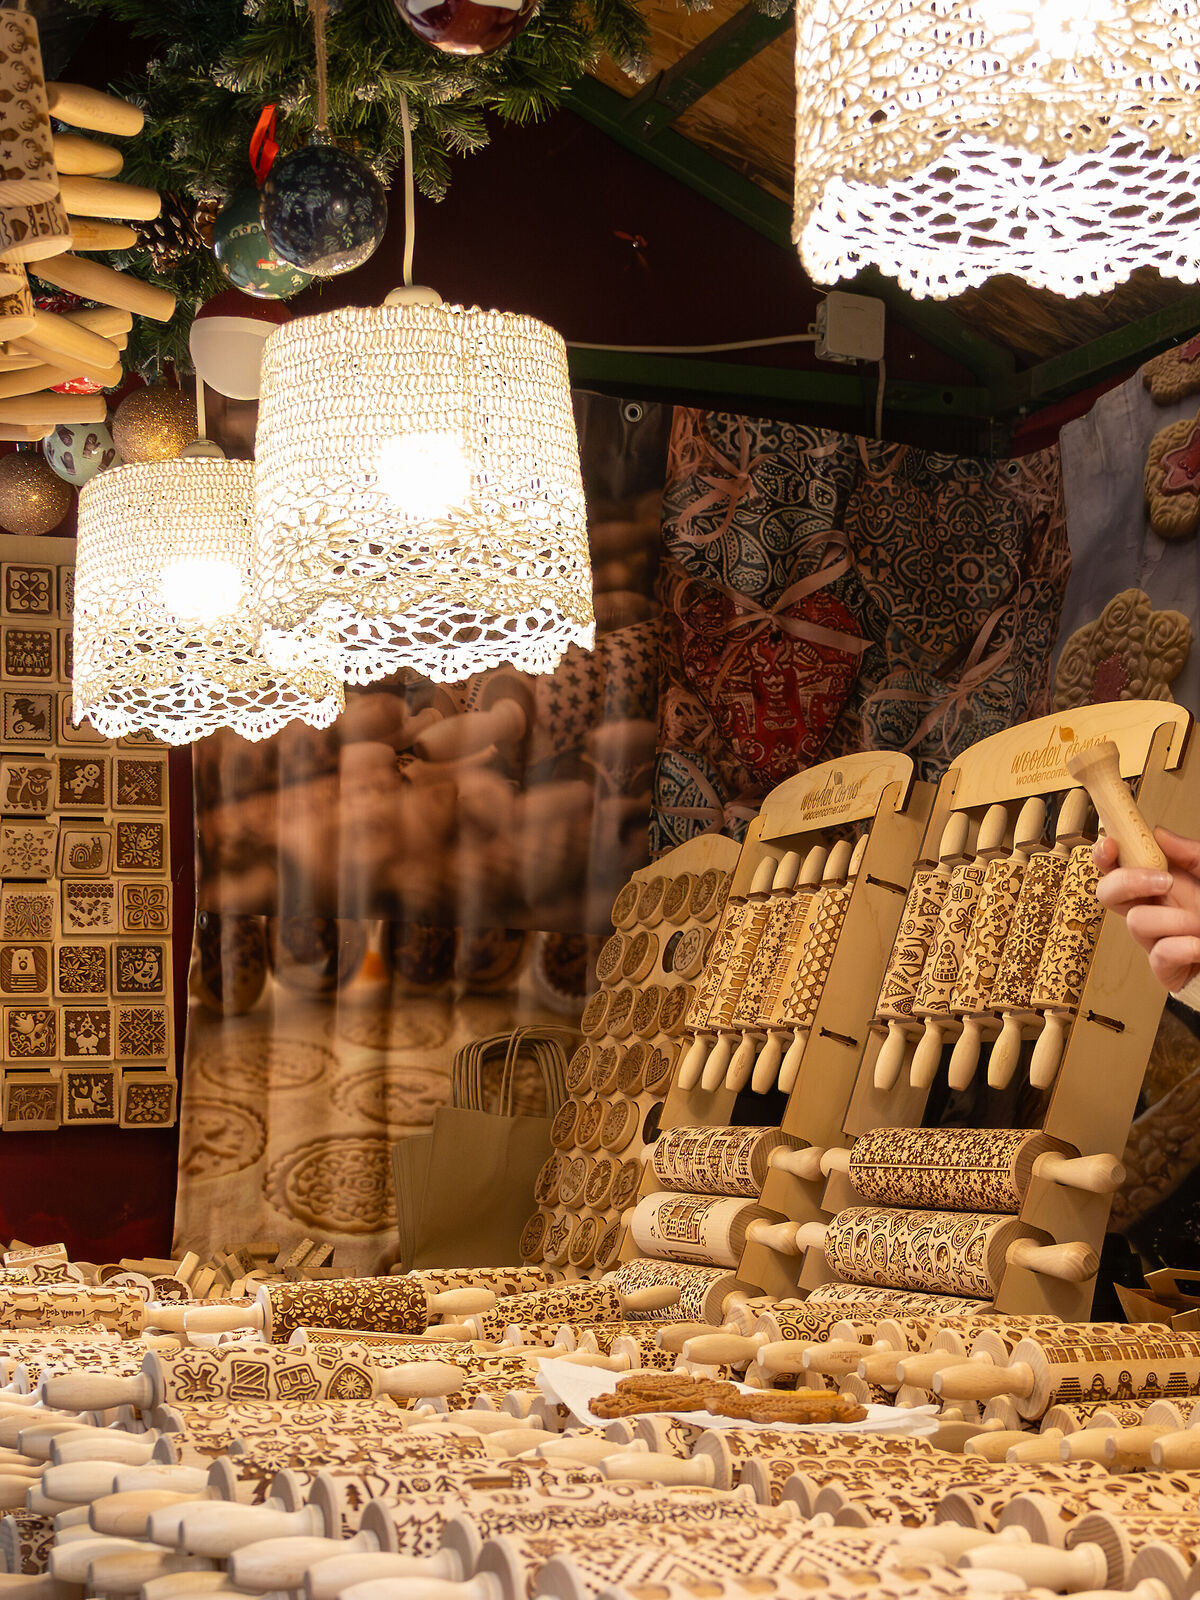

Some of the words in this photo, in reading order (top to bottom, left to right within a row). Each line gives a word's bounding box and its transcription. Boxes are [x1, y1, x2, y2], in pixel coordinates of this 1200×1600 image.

[1010, 724, 1062, 775] wooden
[800, 769, 835, 811] wooden
[802, 803, 851, 820] woodencorner.com
